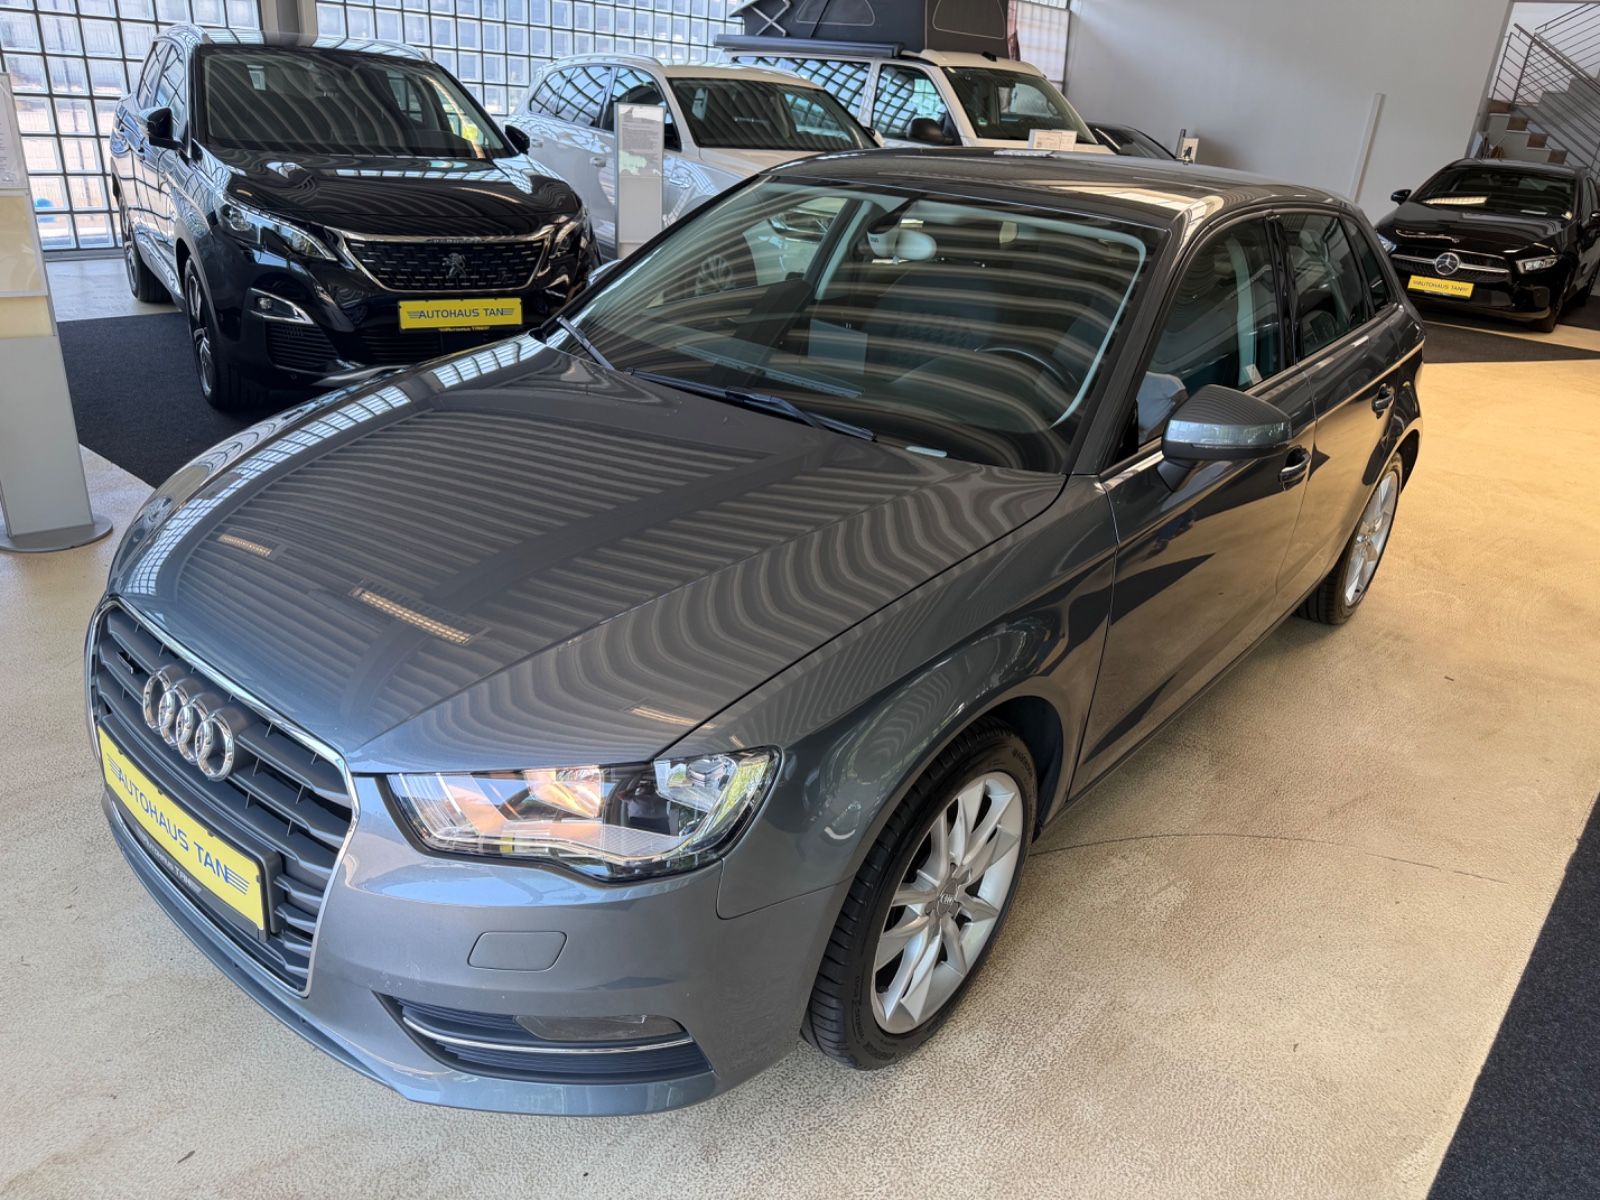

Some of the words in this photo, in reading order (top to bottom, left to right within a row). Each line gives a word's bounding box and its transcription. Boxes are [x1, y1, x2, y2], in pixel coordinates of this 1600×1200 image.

[418, 308, 480, 319] AUTOHAUS
[483, 307, 504, 317] TAN
[118, 766, 190, 852] AUTOHAUS
[194, 841, 230, 883] TAN
